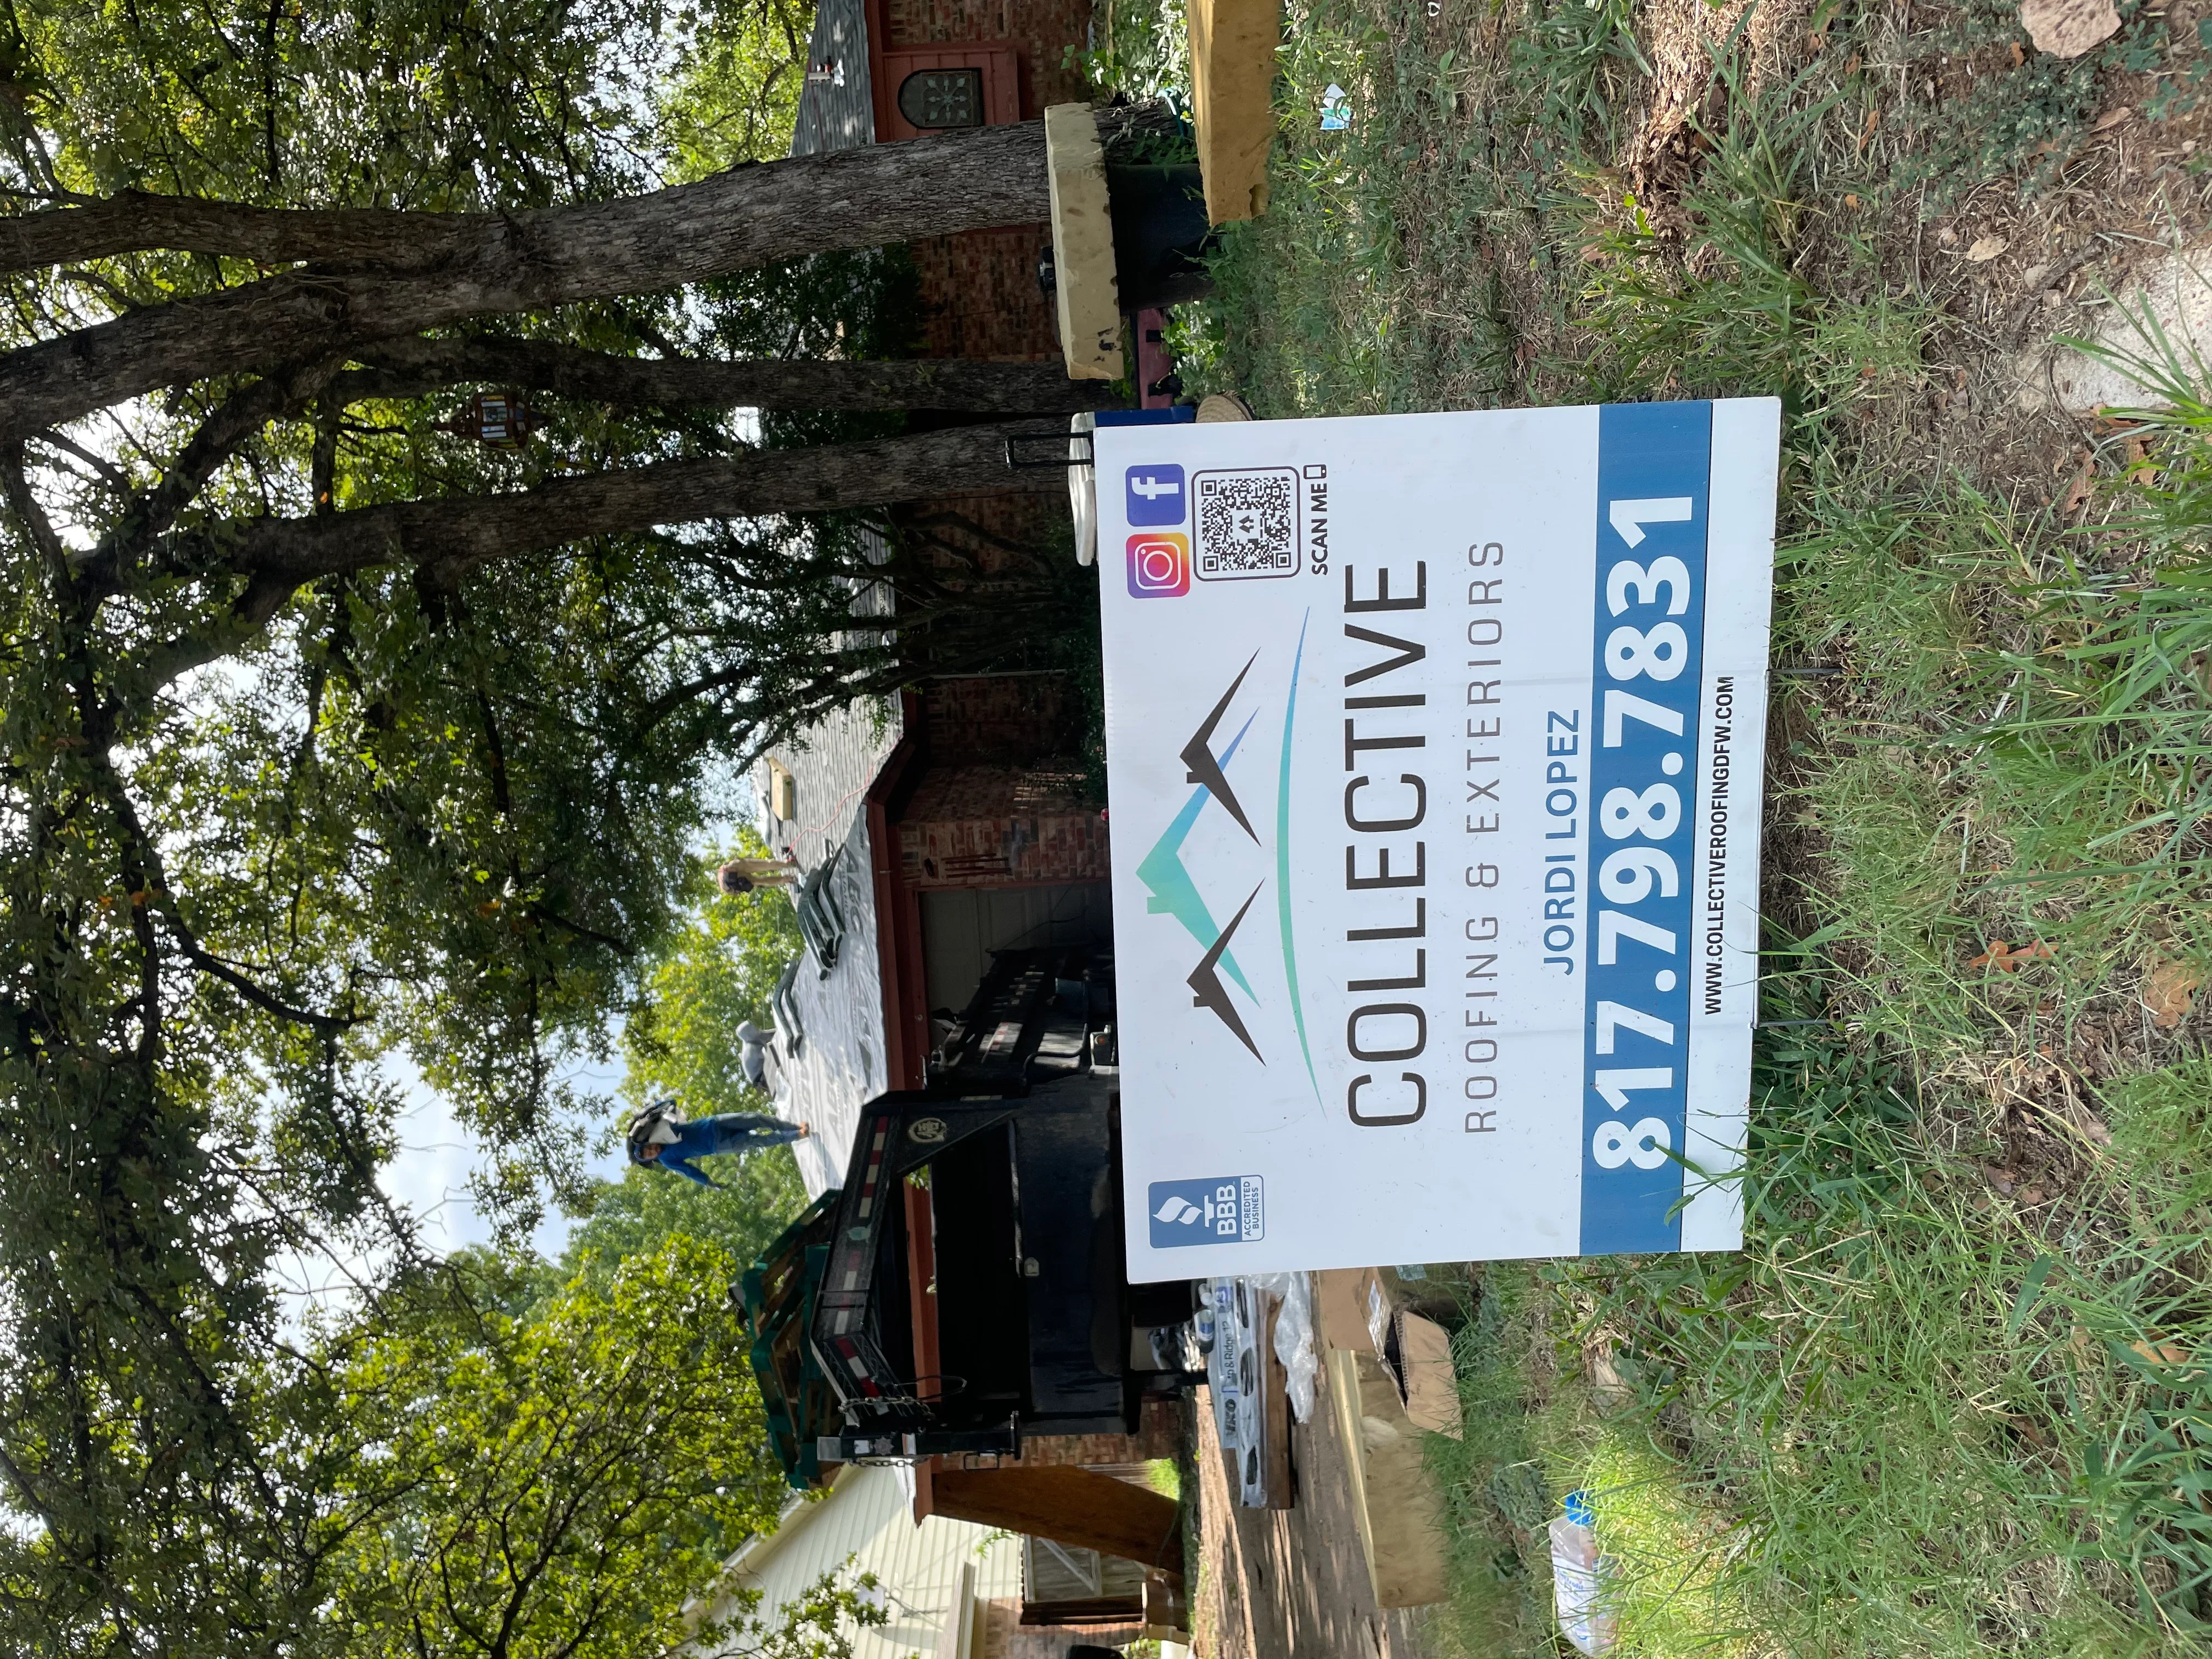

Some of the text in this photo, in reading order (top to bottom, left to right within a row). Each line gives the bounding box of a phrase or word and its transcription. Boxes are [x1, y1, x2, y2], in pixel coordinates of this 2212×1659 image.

[1311, 483, 1328, 575] SCAN ME
[844, 844, 862, 935] ABC
[1344, 561, 1426, 1126] COLLECTIVE
[1465, 543, 1503, 1132] ROOFING & EXTERIORS
[1544, 710, 1578, 975] JORDI LOPEZ
[1592, 496, 1693, 1170] 817.798.7831
[1704, 676, 1735, 1014] WWW.COLLECTIVEROOFINGDFW.COM
[1216, 1185, 1237, 1235] BBB
[1243, 1181, 1251, 1237] ACCREDITED
